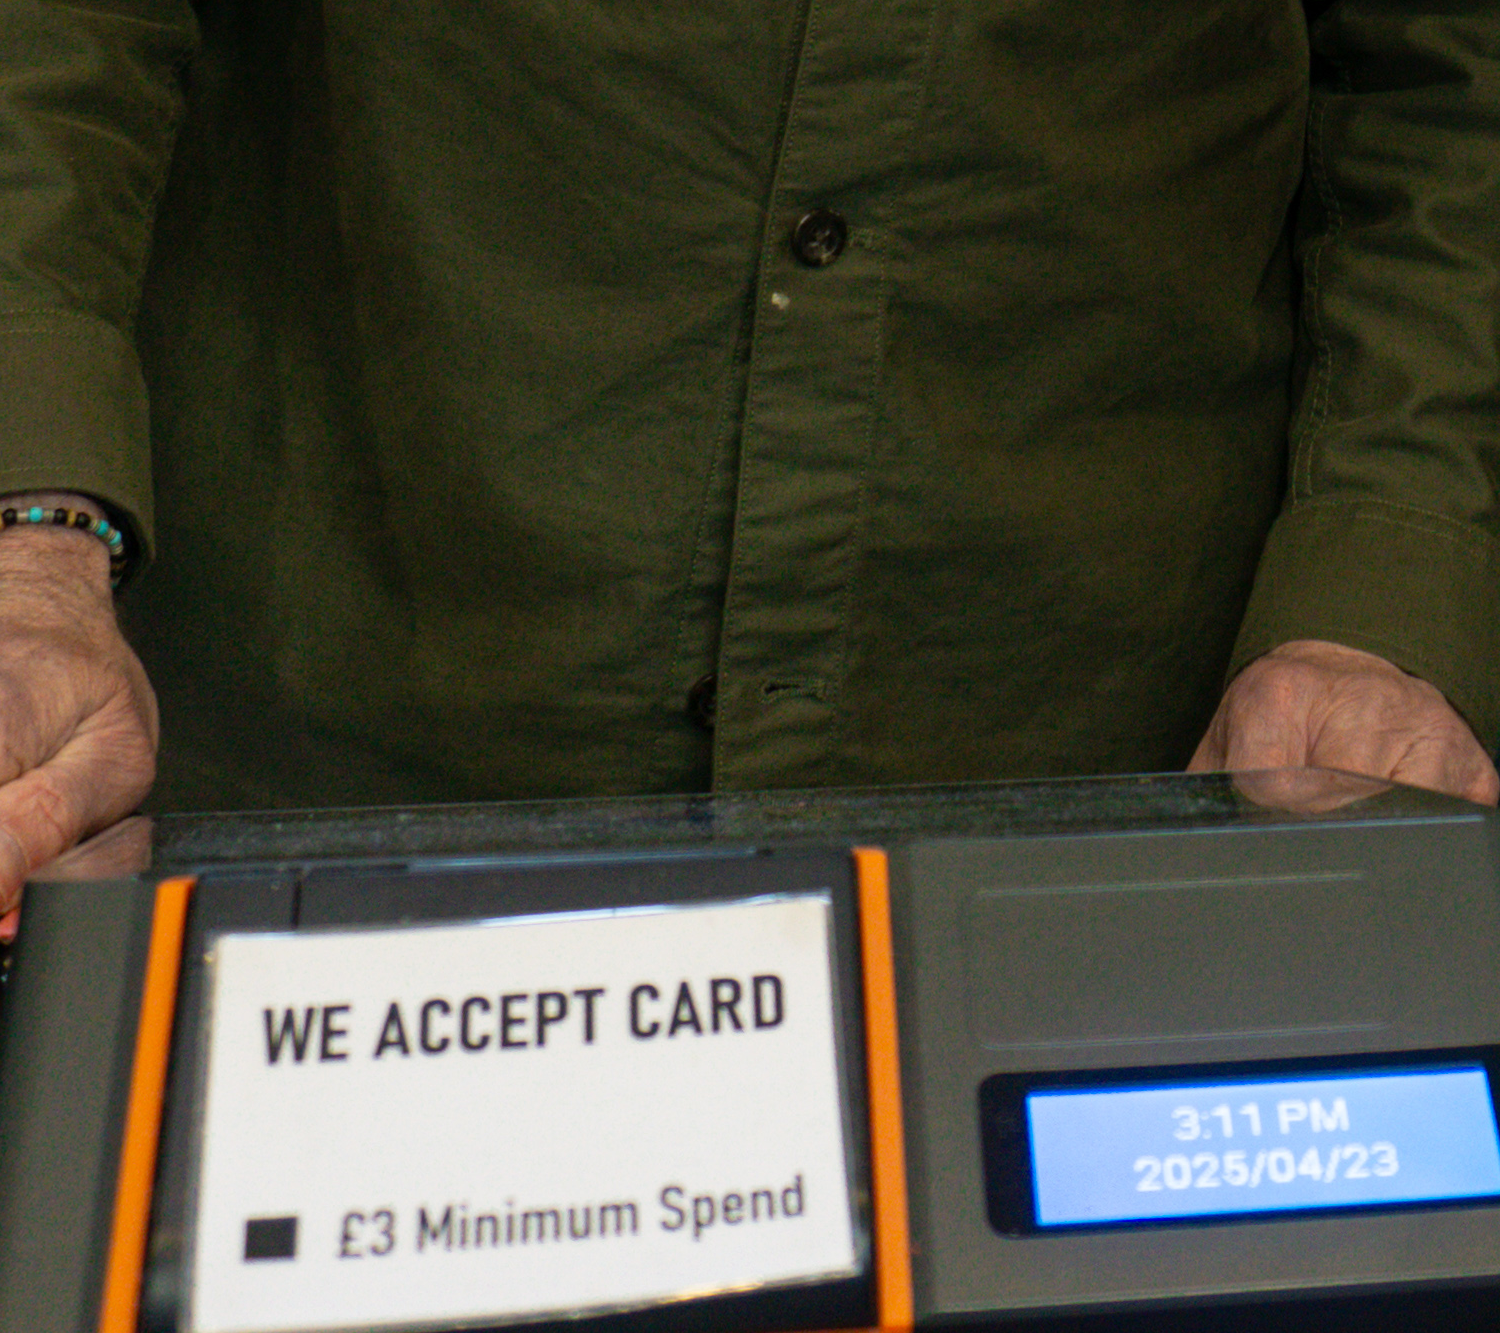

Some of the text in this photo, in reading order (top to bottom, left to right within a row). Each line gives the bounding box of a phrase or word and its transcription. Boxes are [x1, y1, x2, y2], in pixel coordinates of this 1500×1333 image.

[262, 972, 787, 1066] WE ACCEPT CARD
[1171, 1096, 1351, 1142] 3:11 PM
[1133, 1140, 1400, 1193] 2025/04/23
[337, 1172, 807, 1260] £3 Minimum Spend
